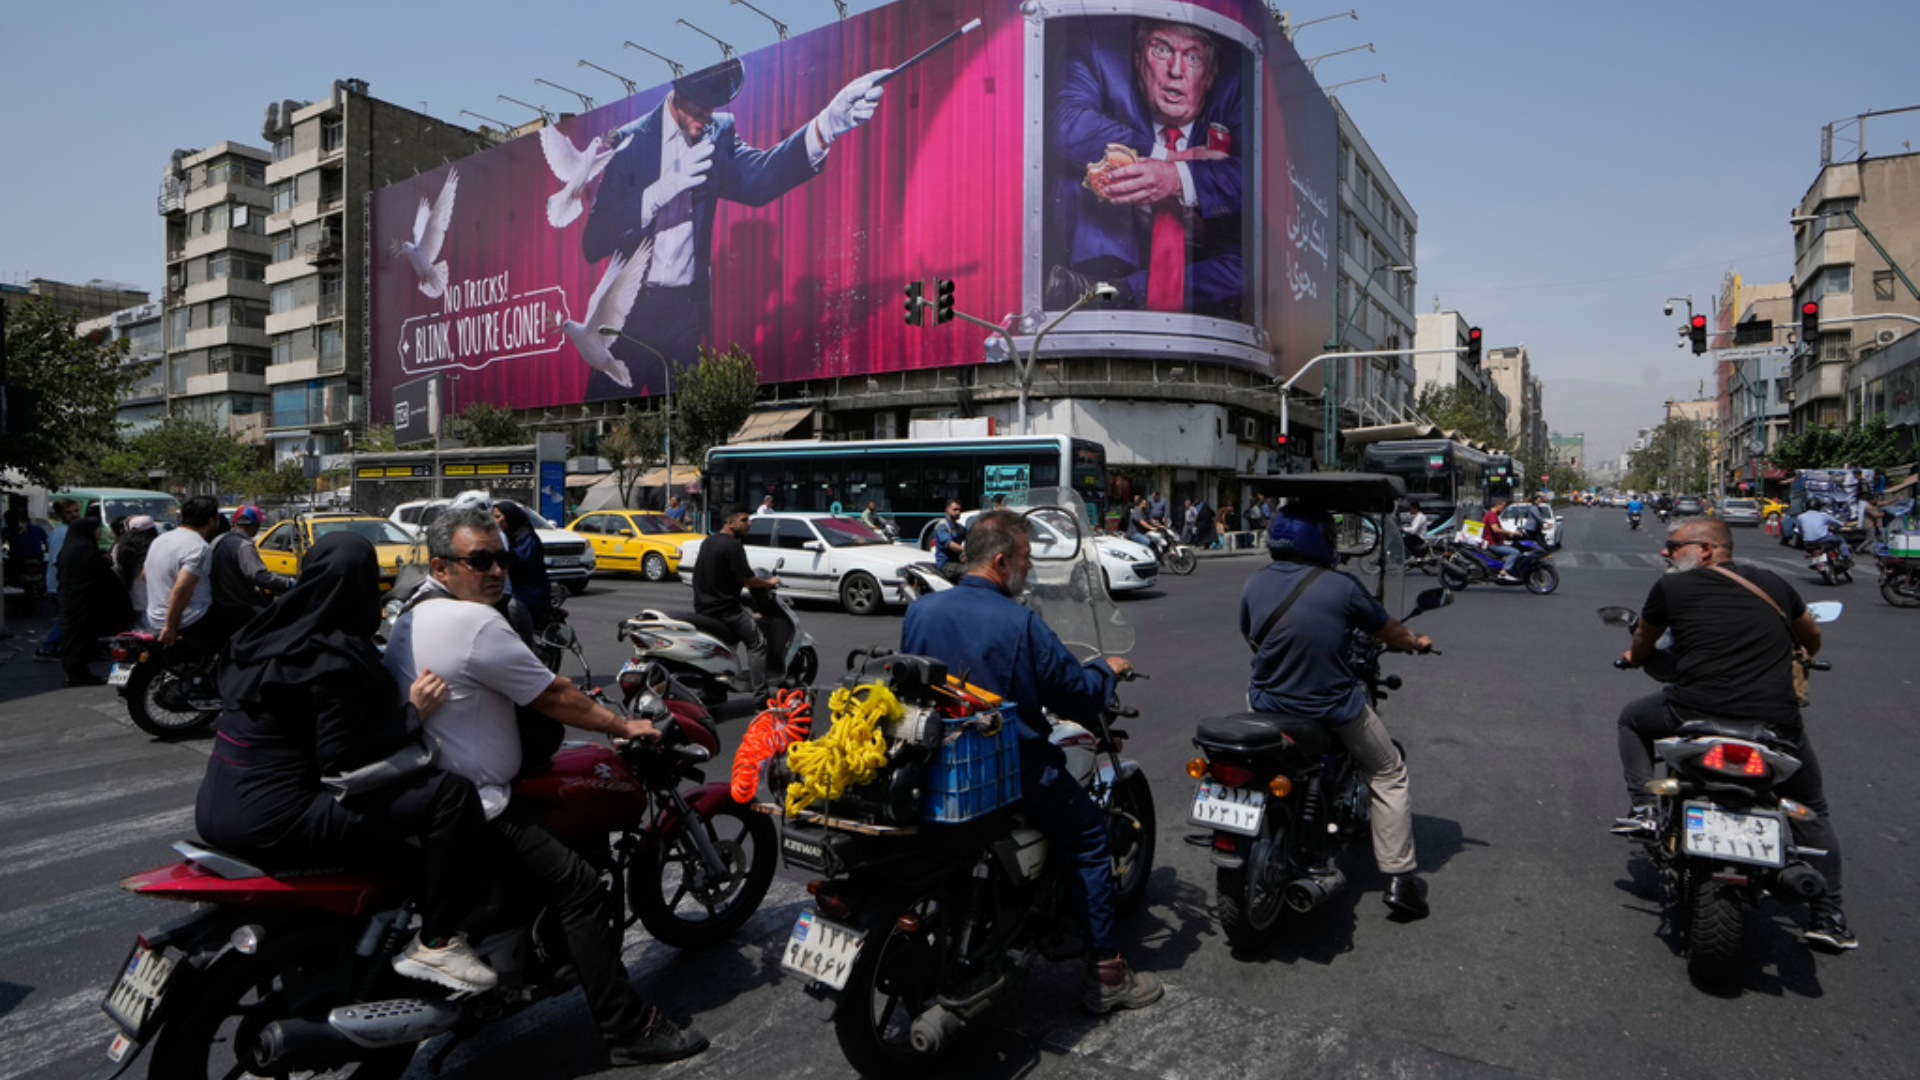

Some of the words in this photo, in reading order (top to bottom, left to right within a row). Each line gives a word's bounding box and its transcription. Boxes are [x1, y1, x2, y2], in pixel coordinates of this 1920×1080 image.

[444, 284, 461, 314] NO
[464, 271, 509, 308] TRICKS!
[415, 320, 455, 364] BLINK,
[457, 311, 499, 357] YOU'RE
[503, 301, 546, 350] GONE!
